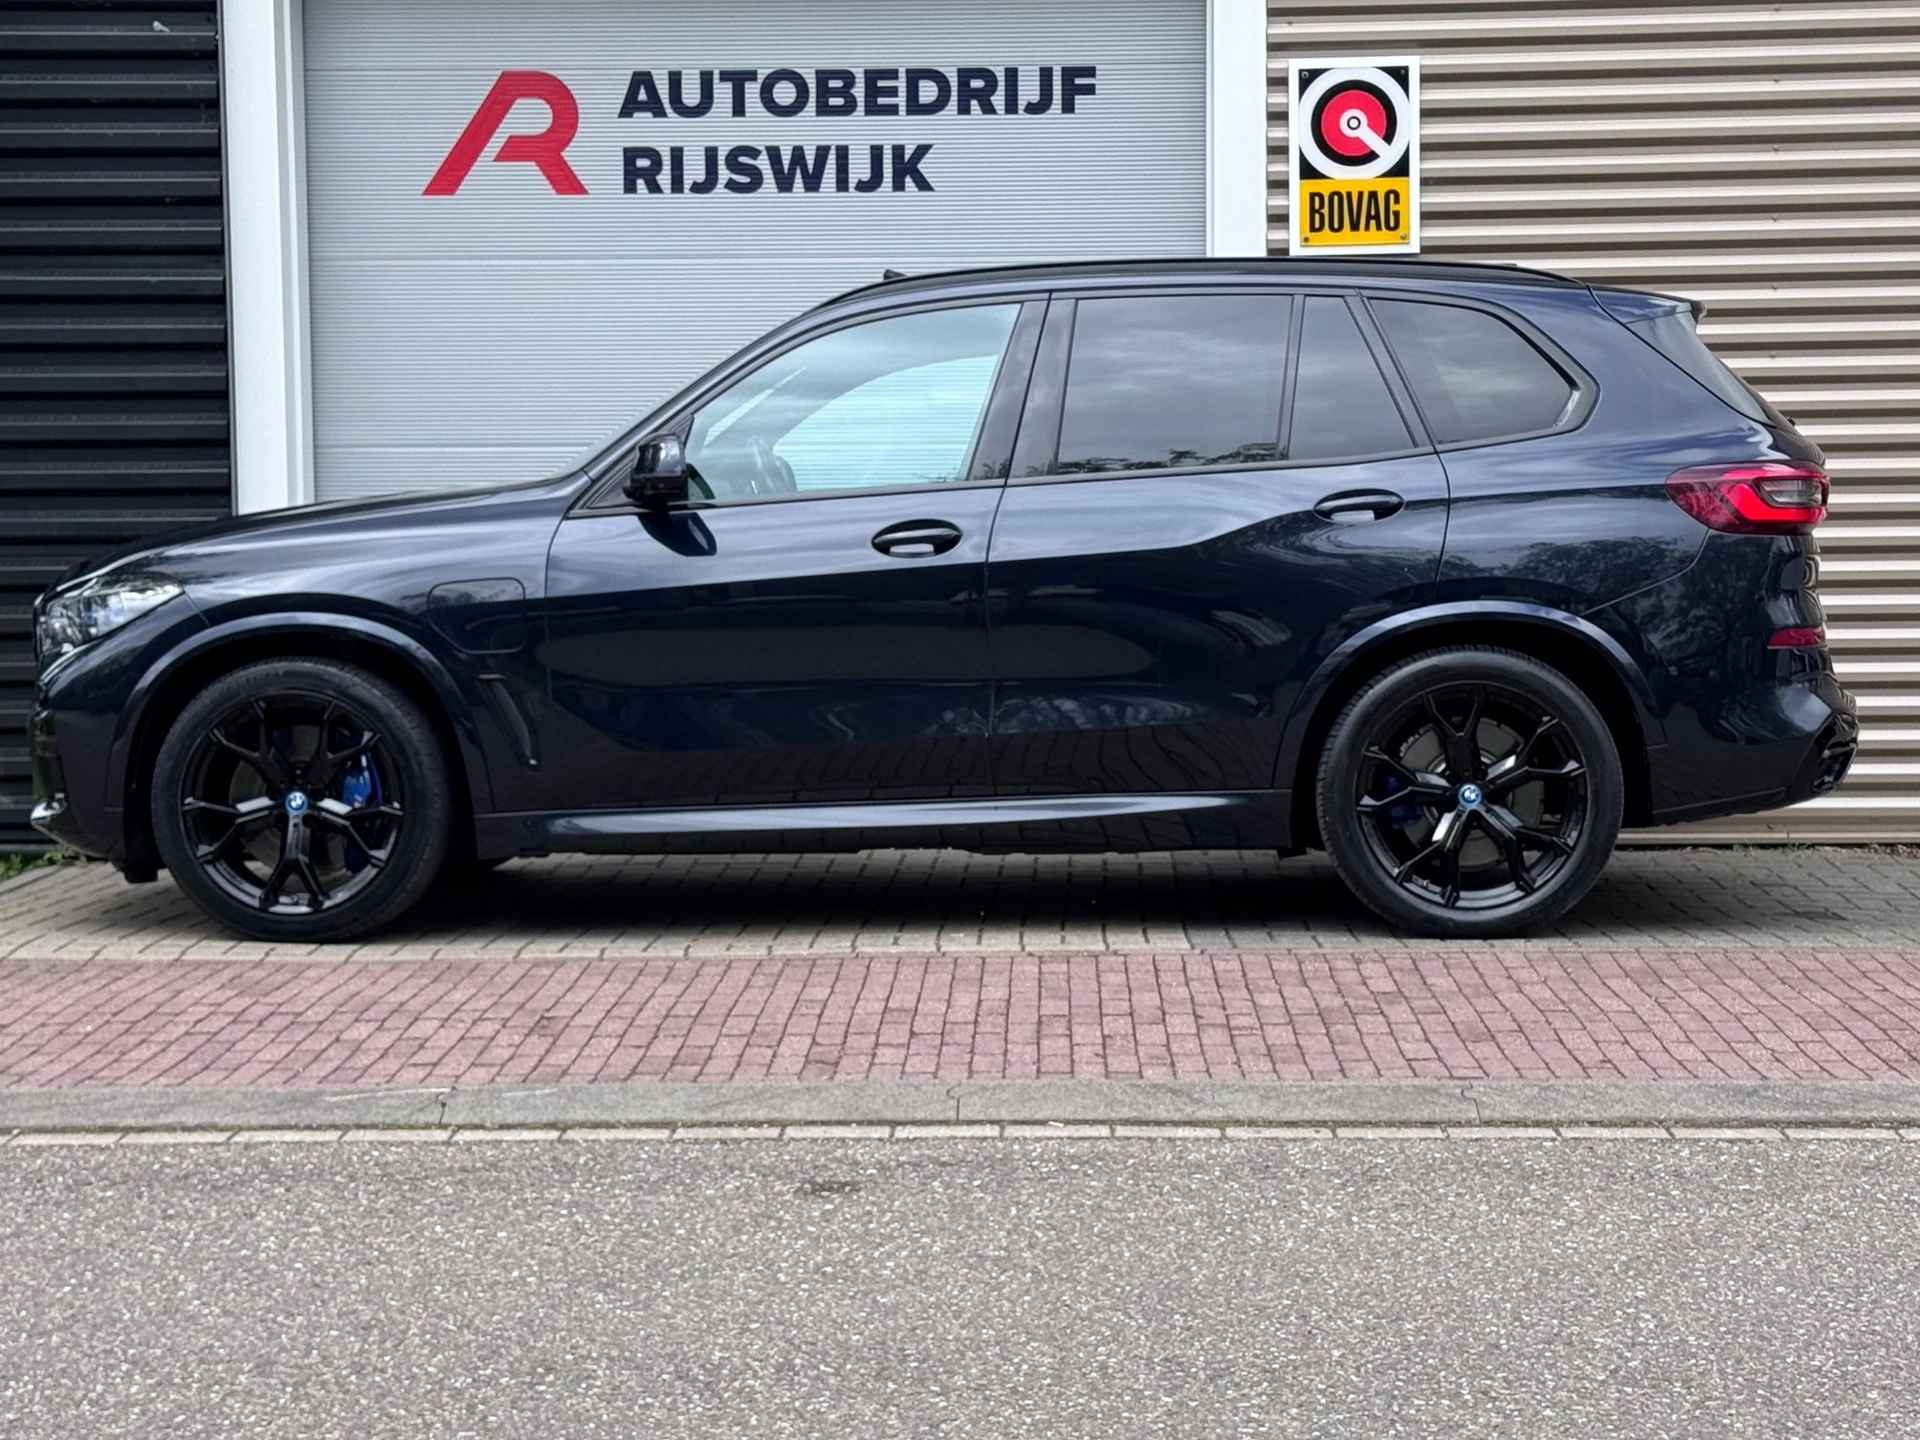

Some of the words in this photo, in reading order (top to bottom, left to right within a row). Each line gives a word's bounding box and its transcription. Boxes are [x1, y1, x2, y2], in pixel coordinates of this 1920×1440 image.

[618, 66, 1097, 118] AUTOBEDRIJF
[622, 144, 934, 194] RIJSWIJK
[1309, 189, 1400, 233] BOVAG
